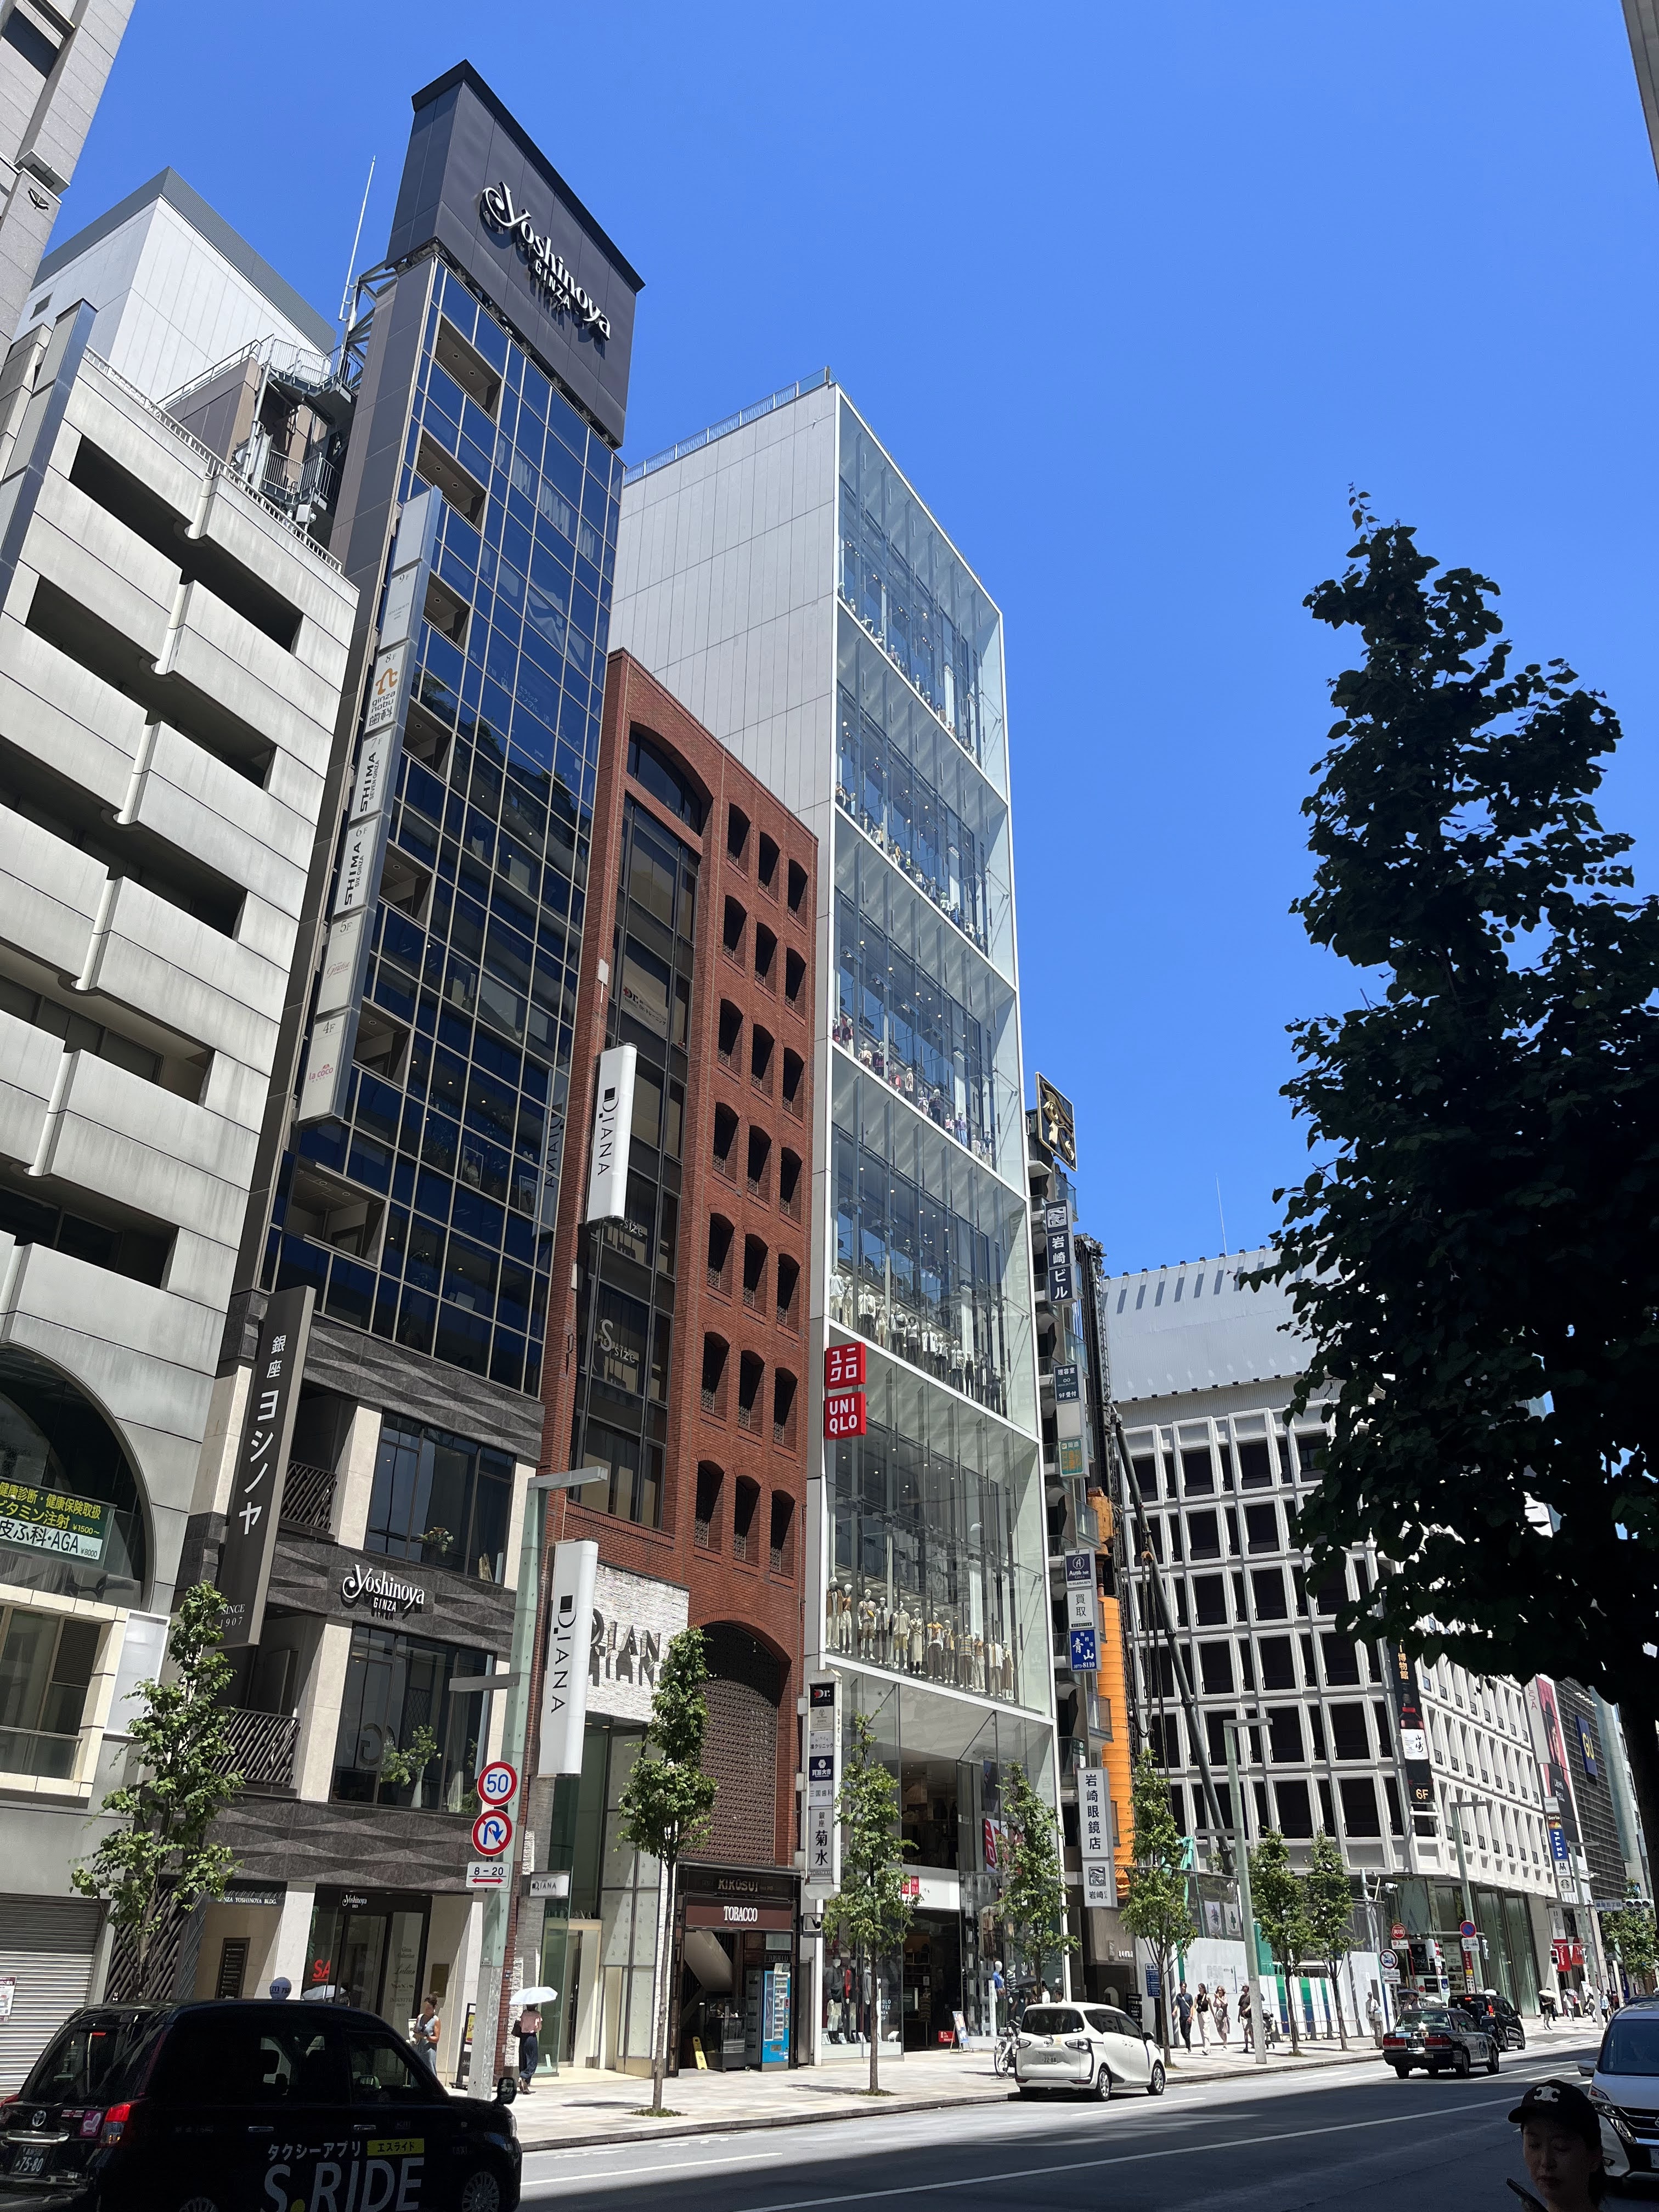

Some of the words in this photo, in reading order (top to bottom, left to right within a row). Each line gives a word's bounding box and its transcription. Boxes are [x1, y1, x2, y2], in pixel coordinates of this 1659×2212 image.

[482, 182, 611, 340] Yoshinoya
[534, 259, 571, 310] GINZA
[371, 698, 394, 713] nobu
[372, 690, 396, 707] ginza
[369, 706, 392, 726] 歯科
[360, 752, 376, 812] SHIMA
[345, 841, 362, 905] SHIMA
[597, 1086, 620, 1177] DIANA
[1052, 1235, 1068, 1299] 岩崎ビル
[614, 1345, 635, 1364] size
[343, 1564, 425, 1610] Yoshinoya
[373, 1597, 396, 1612] GINZA
[1076, 1594, 1086, 1617] 買取
[551, 1595, 577, 1714] DIANA
[1582, 1733, 1594, 1760] GU
[487, 1774, 509, 1793] 50
[1416, 1788, 1428, 1800] 6F
[1086, 1774, 1101, 1849] 岩崎眼鏡店
[1554, 1831, 1563, 1858] PLAZA
[724, 1906, 758, 1922] TOBACCO
[268, 2141, 360, 2162] タクシーアプリ
[377, 2142, 415, 2152] エスライド
